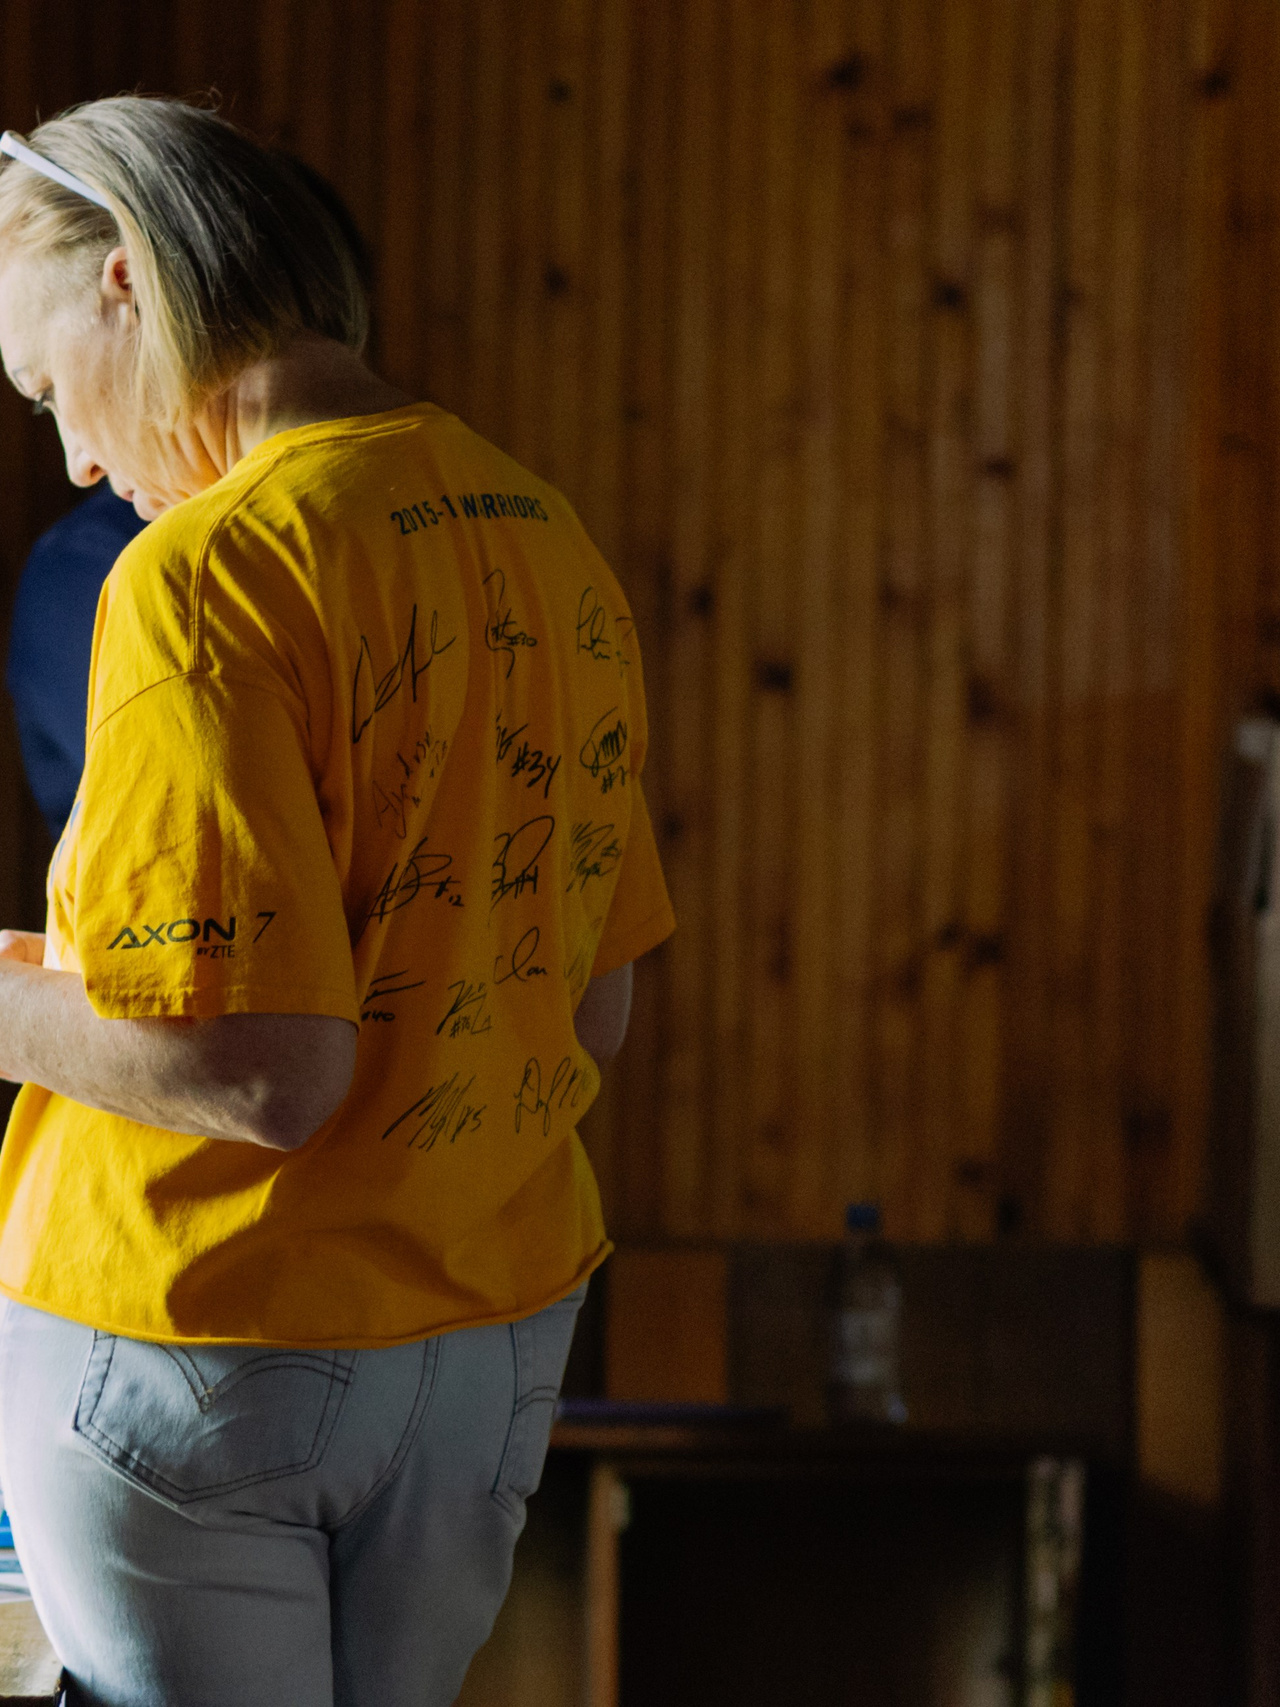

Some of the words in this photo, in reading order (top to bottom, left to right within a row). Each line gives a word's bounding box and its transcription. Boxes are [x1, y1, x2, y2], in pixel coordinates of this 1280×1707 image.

[458, 493, 549, 522] WRRIORS
[106, 916, 237, 950] AXON
[252, 911, 277, 943] 7
[210, 944, 236, 959] ZTE
